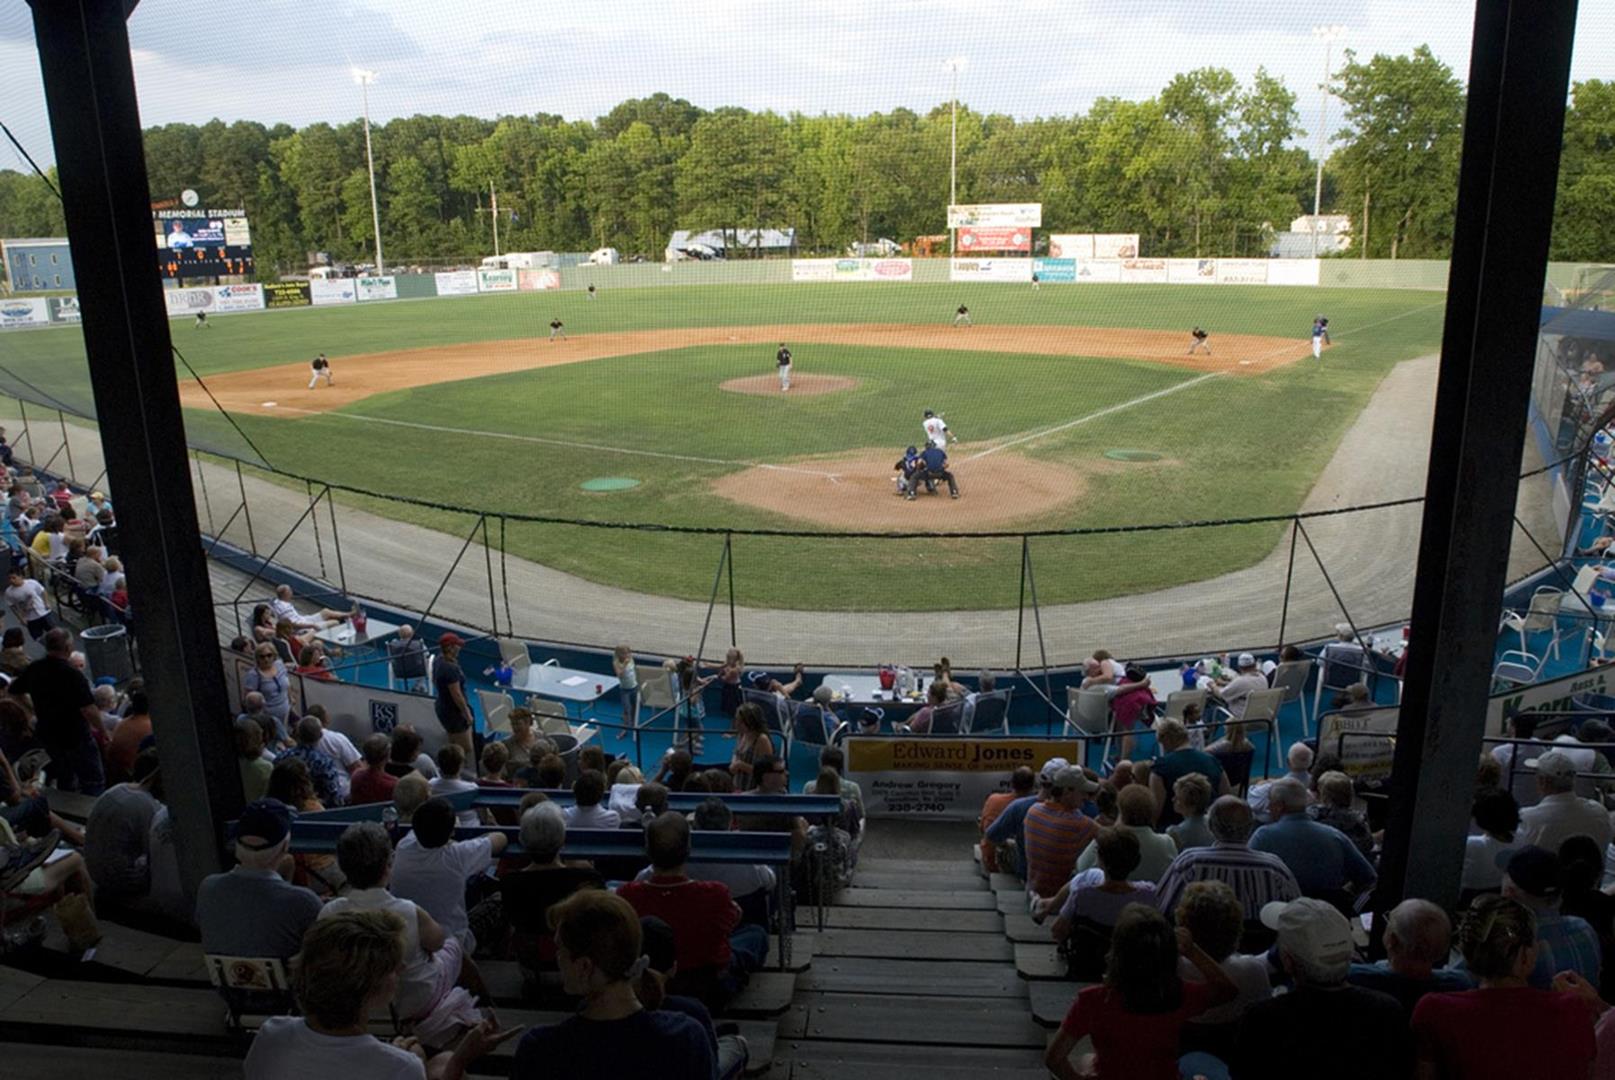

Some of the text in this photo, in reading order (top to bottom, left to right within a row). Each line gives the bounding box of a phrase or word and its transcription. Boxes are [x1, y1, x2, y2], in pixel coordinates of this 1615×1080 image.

[158, 210, 206, 219] MEMORIAL
[208, 209, 245, 218] STADIUM
[893, 743, 1034, 761] Edward Jones
[893, 761, 929, 770] MAKING
[872, 780, 961, 791] Andrew Gregory
